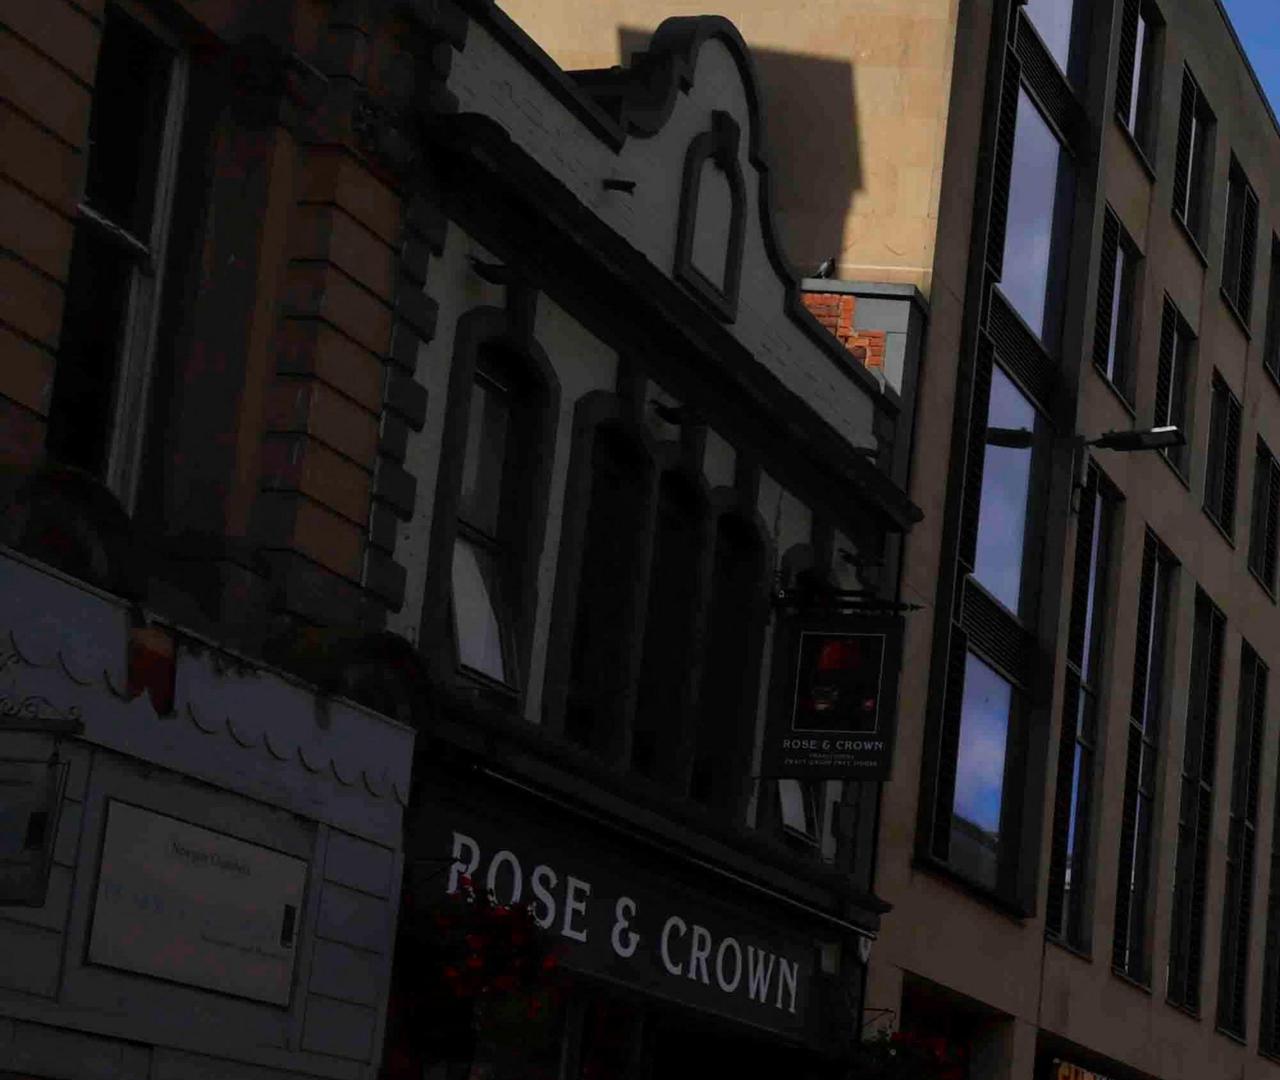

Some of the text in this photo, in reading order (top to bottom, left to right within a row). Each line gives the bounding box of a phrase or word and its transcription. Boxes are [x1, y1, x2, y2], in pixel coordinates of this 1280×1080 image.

[783, 739, 885, 750] ROSE & CROWN
[446, 829, 799, 1014] ROSE & CROWN
